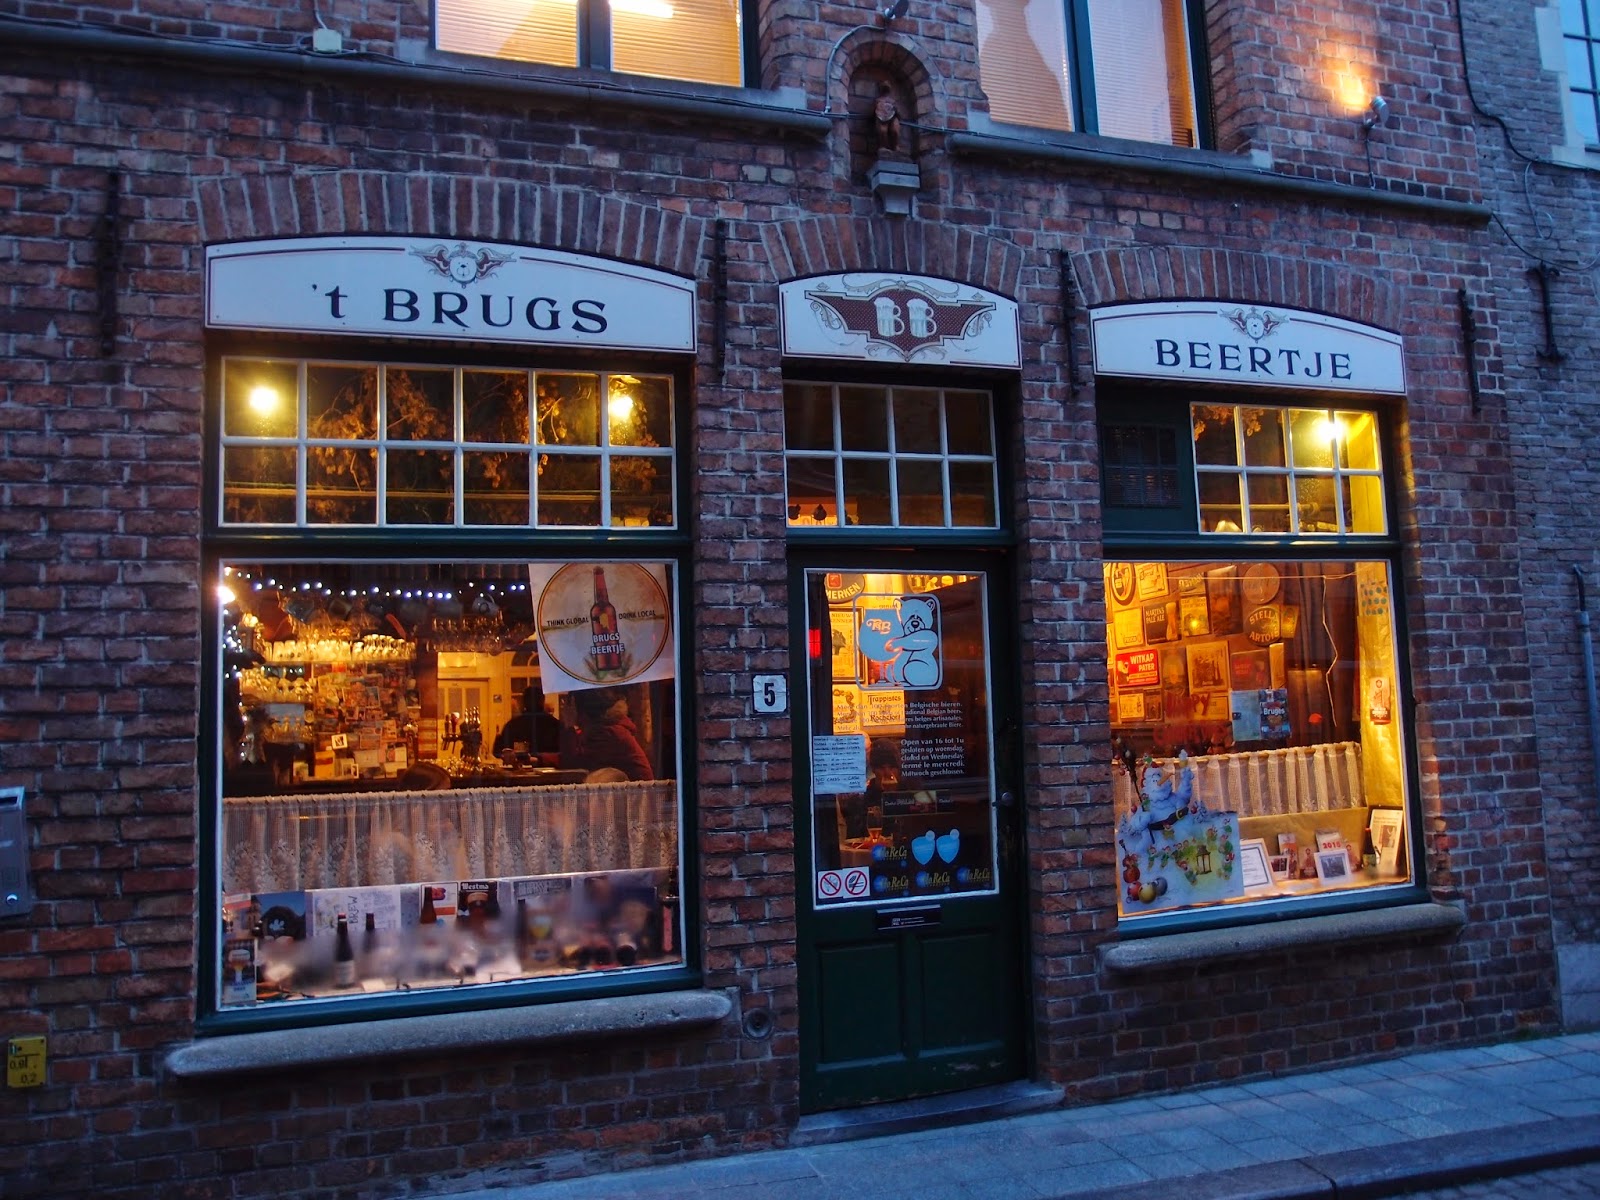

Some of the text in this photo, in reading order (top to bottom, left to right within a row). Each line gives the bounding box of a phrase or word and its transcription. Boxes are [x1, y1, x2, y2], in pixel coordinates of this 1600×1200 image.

[311, 284, 608, 334] 't BRUGS
[1155, 339, 1353, 381] BEERTJE
[546, 609, 656, 627] THINK GLOBAL DRINK LOCAL
[1249, 610, 1278, 625] STELLA
[592, 632, 620, 643] BRUGS
[1249, 631, 1280, 643] ARTOIS
[591, 643, 625, 655] BEERTJE
[1130, 653, 1155, 664] WITKAP
[1138, 663, 1155, 672] PATER
[764, 682, 776, 707] 5
[1263, 708, 1286, 716] Bruges
[901, 747, 925, 755] gesloten
[901, 769, 930, 777] Mittwoch
